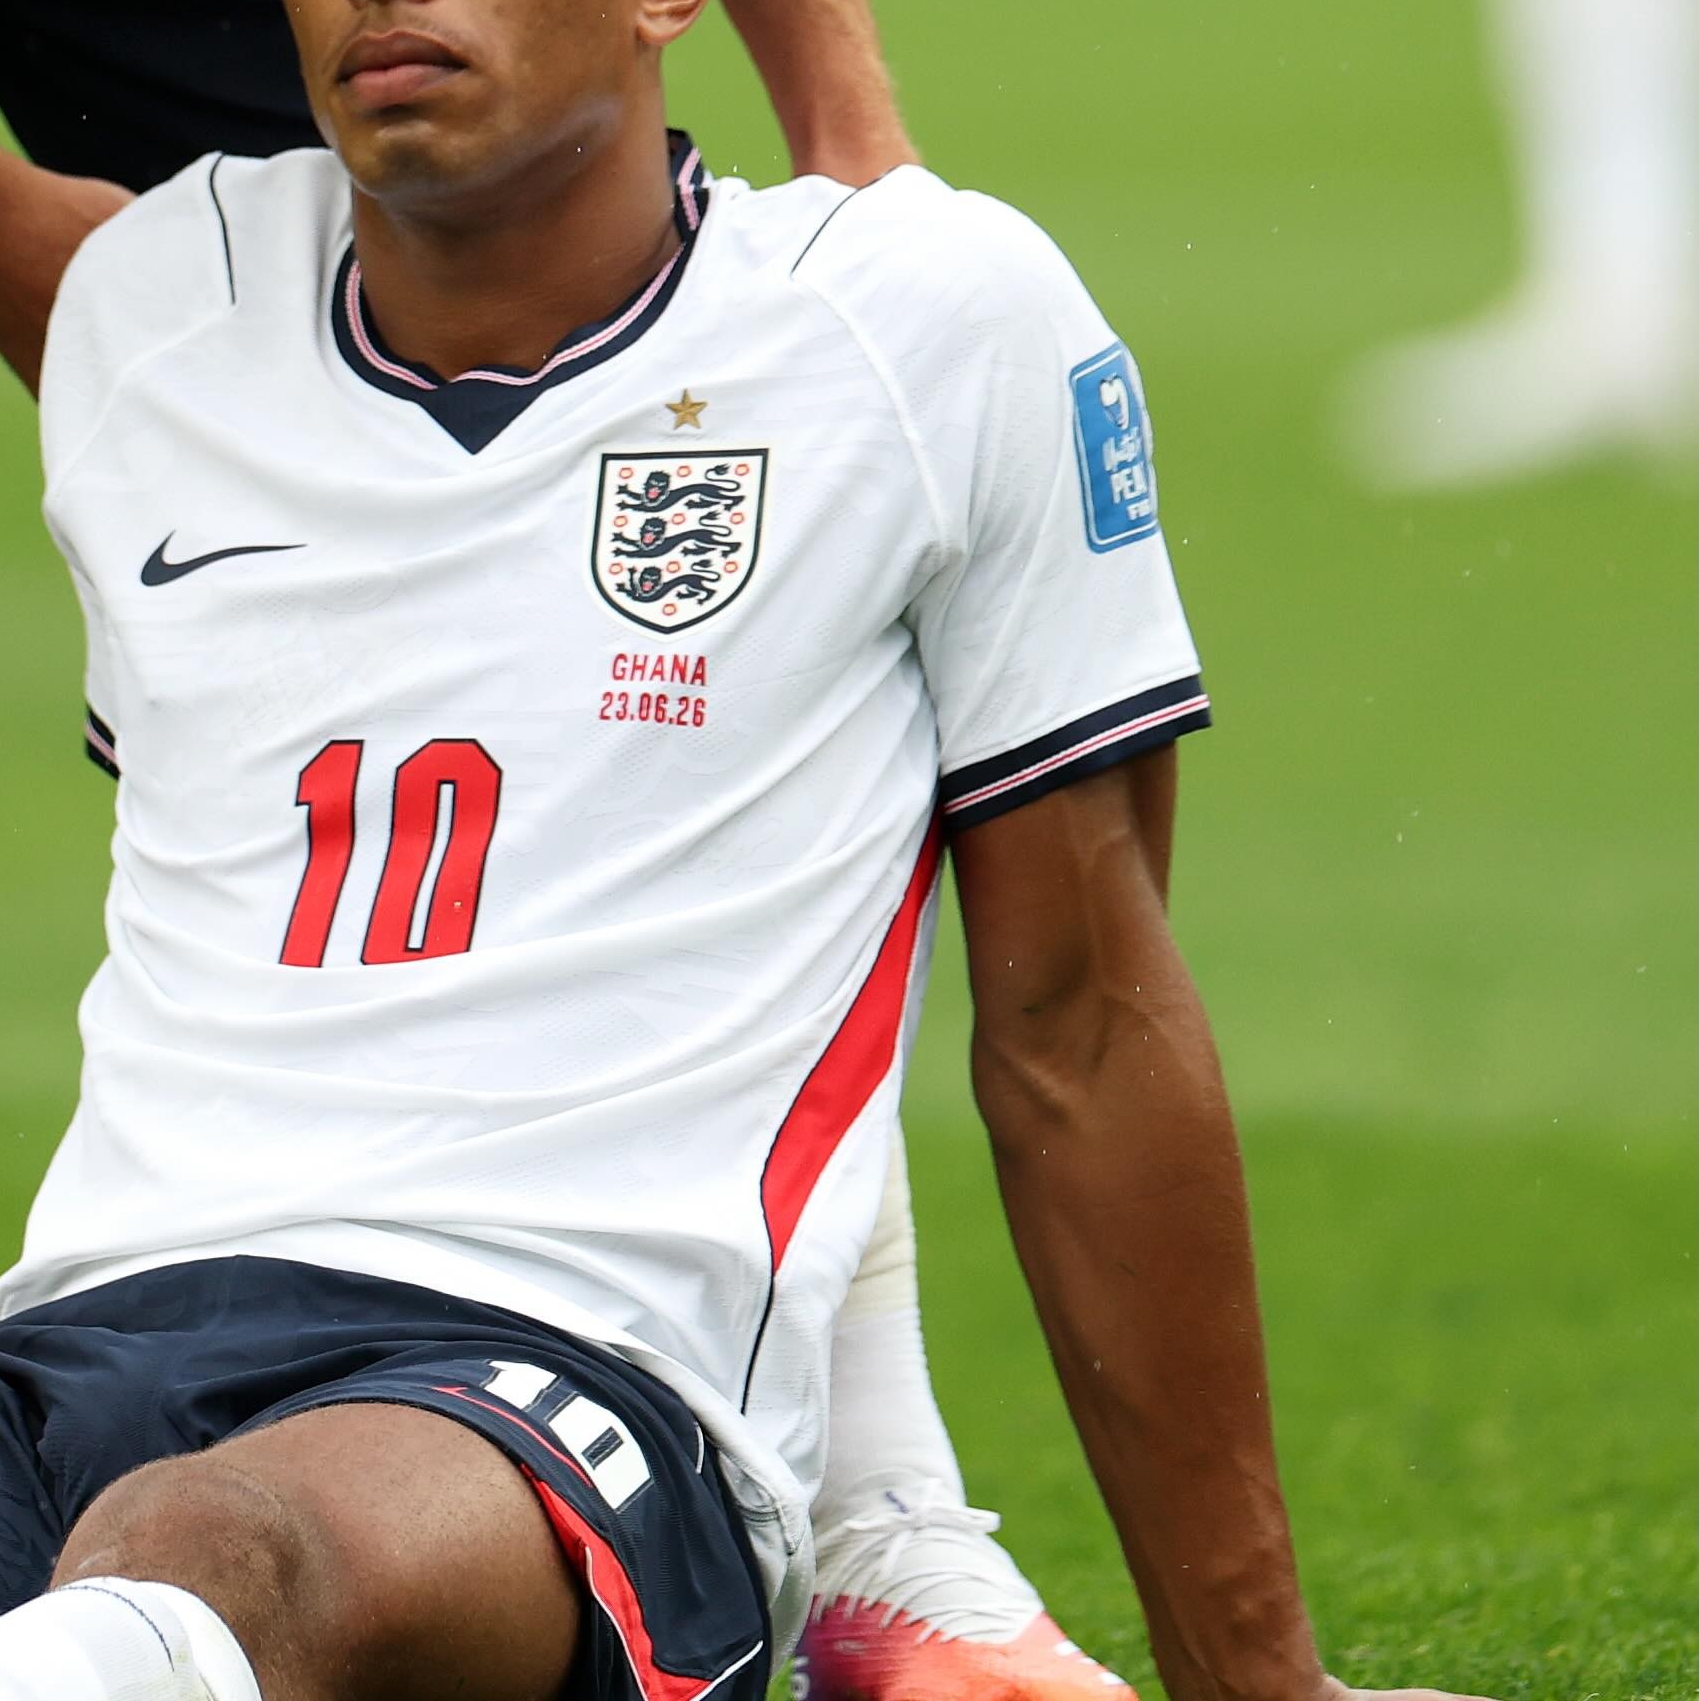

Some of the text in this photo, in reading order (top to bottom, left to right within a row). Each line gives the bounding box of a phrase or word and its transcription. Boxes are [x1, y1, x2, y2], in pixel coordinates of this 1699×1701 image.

[612, 653, 707, 686] GHANA
[599, 691, 706, 728] 23.06.26
[279, 738, 502, 967] 10
